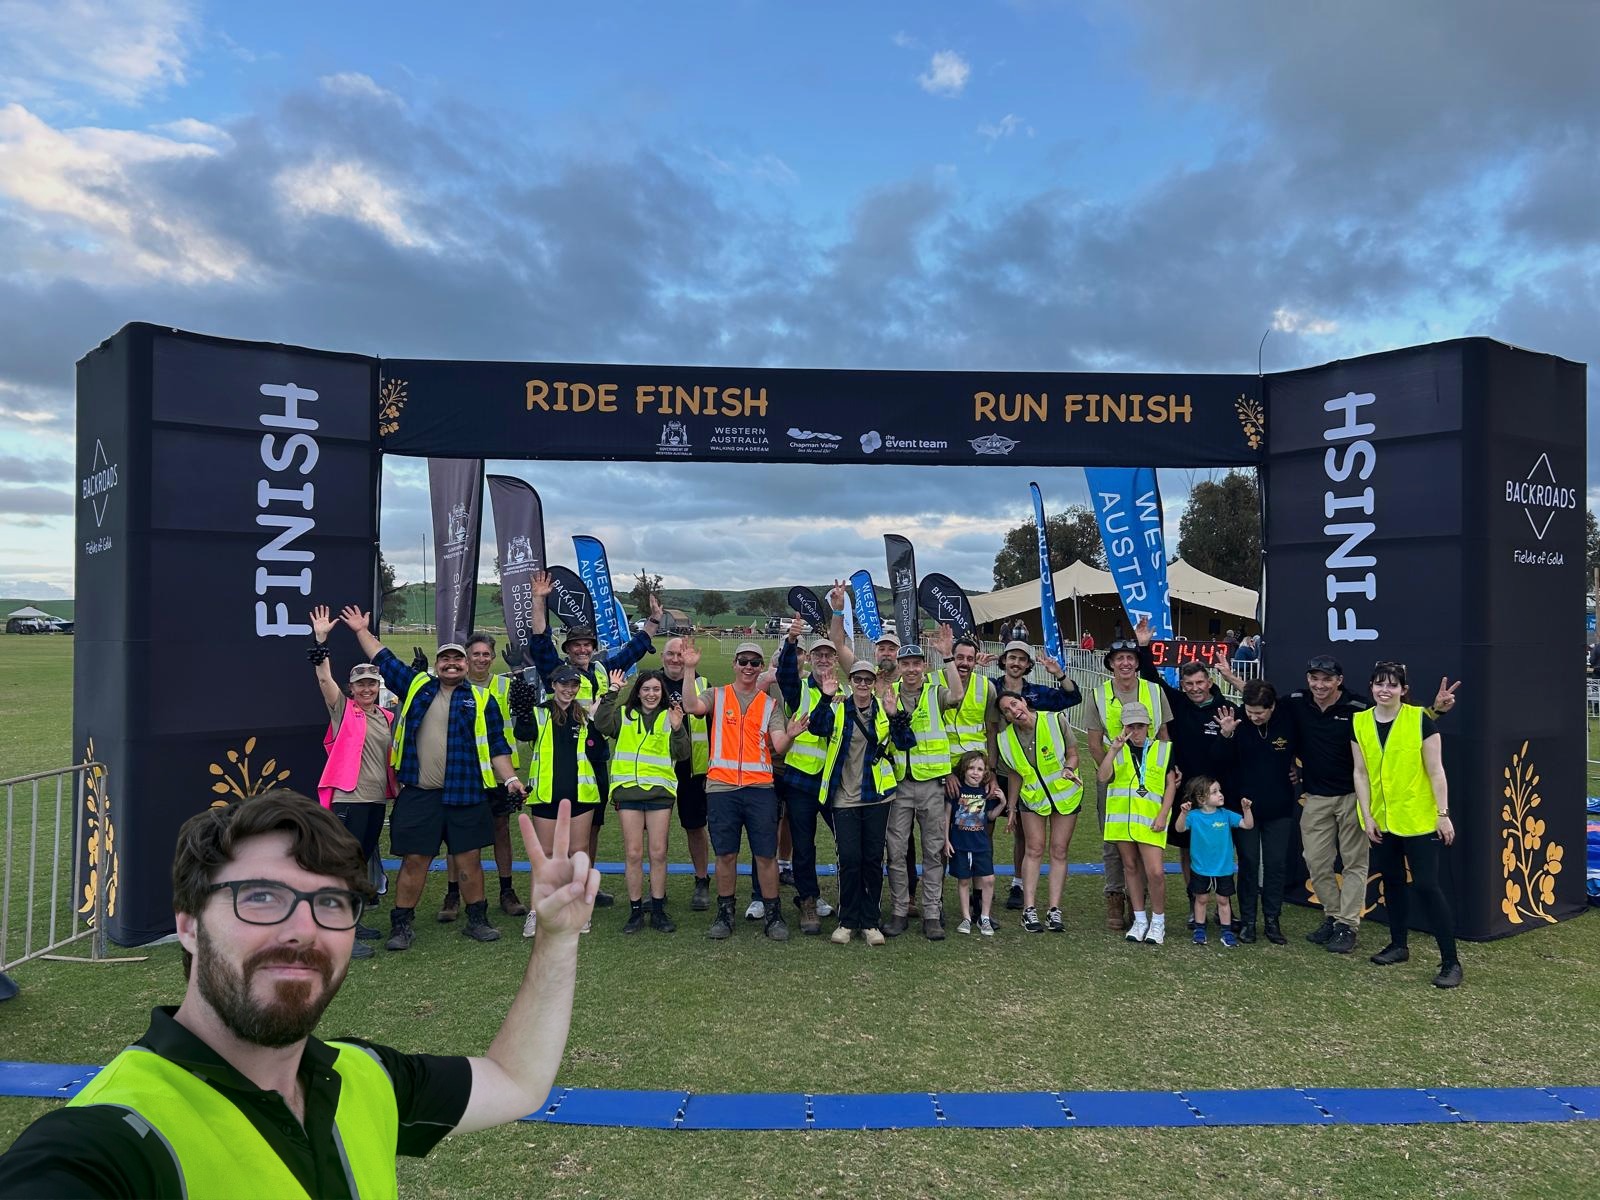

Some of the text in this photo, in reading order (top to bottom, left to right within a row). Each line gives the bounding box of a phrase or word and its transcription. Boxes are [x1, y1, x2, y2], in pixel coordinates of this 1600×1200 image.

[525, 380, 769, 418] RIDE FINISH
[973, 391, 1193, 424] RUN FINISH
[710, 436, 769, 444] AUSTRALIA
[714, 427, 766, 435] WESTERN
[885, 439, 948, 448] event team
[82, 463, 118, 500] BACKROADS
[1505, 480, 1576, 509] BACKROADS
[255, 382, 320, 637] FINISH
[1323, 391, 1379, 642] FINISH
[1514, 549, 1564, 565] Fields of Gold
[511, 584, 529, 647] SPONSOR
[553, 578, 589, 627] BACKROADS
[593, 559, 619, 640] WESTERN
[796, 593, 821, 621] BACKROADS
[901, 598, 911, 638] SPONSOR
[931, 586, 968, 631] BACKROADS
